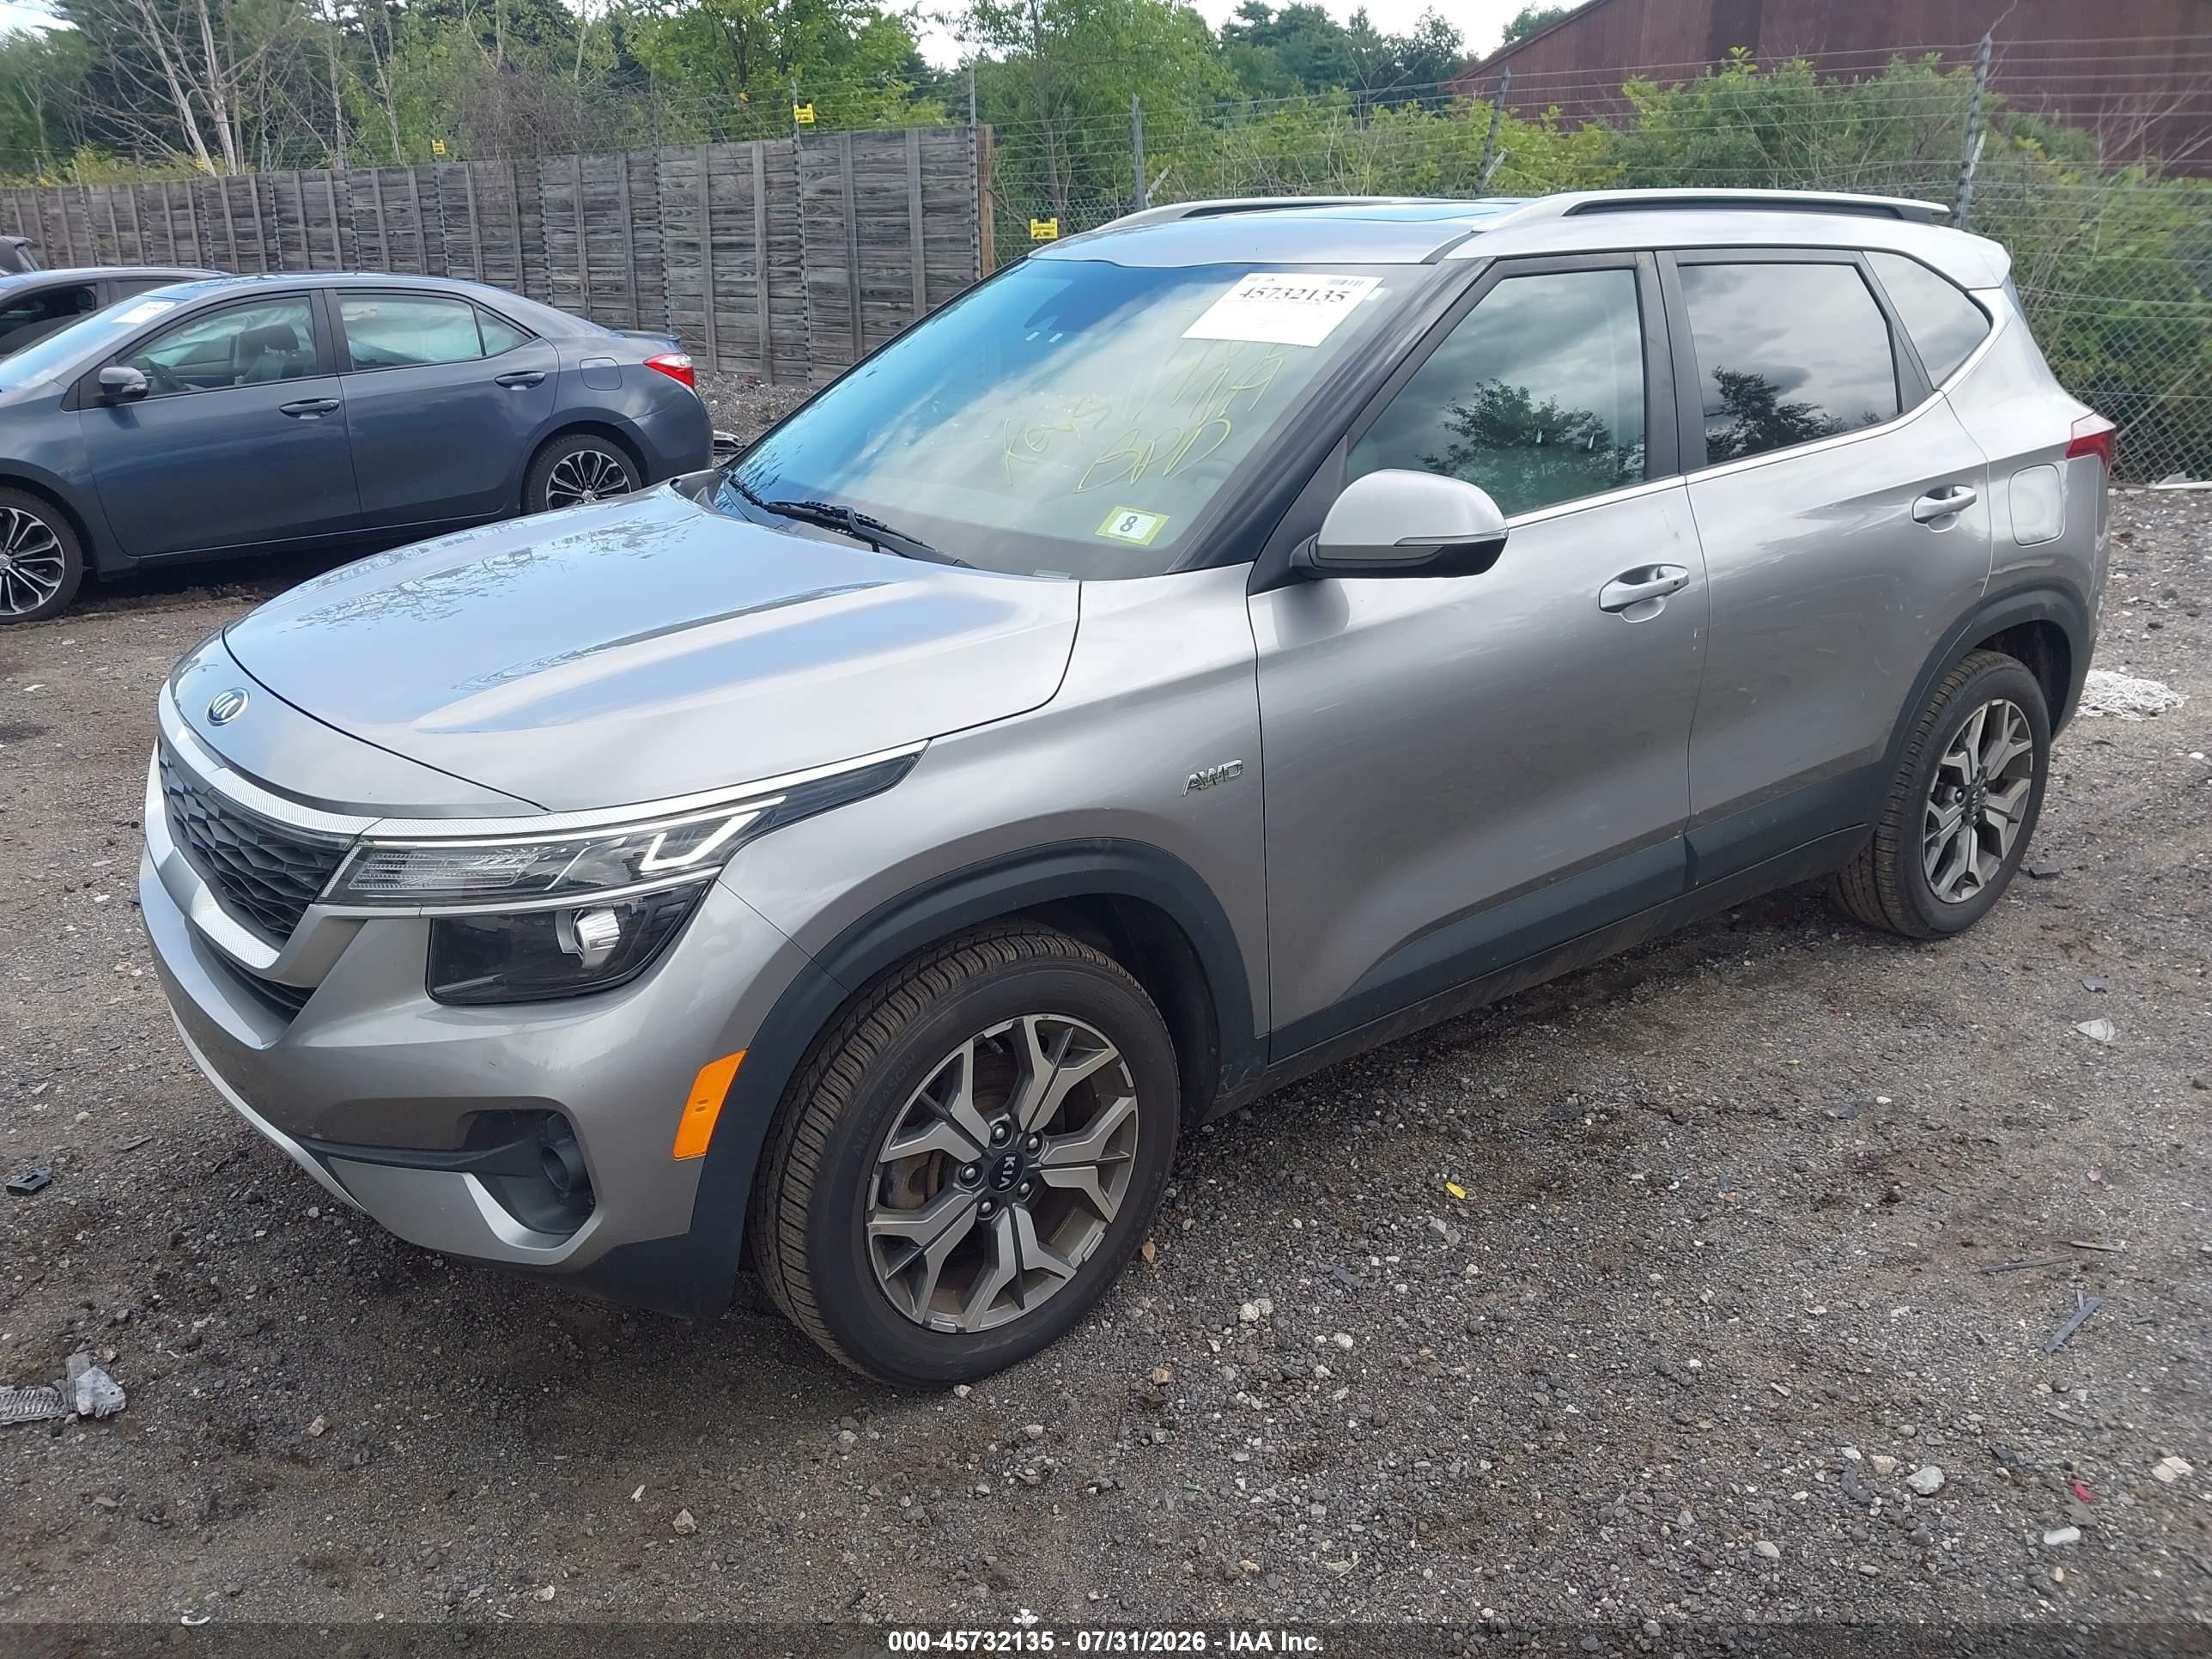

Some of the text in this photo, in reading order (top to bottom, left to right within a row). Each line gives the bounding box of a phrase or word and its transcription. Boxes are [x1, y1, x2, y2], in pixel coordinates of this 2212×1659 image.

[1238, 286, 1352, 303] 45732135
[1119, 515, 1139, 532] 8
[1182, 759, 1243, 796] AWD
[998, 1155, 1016, 1189] KIA
